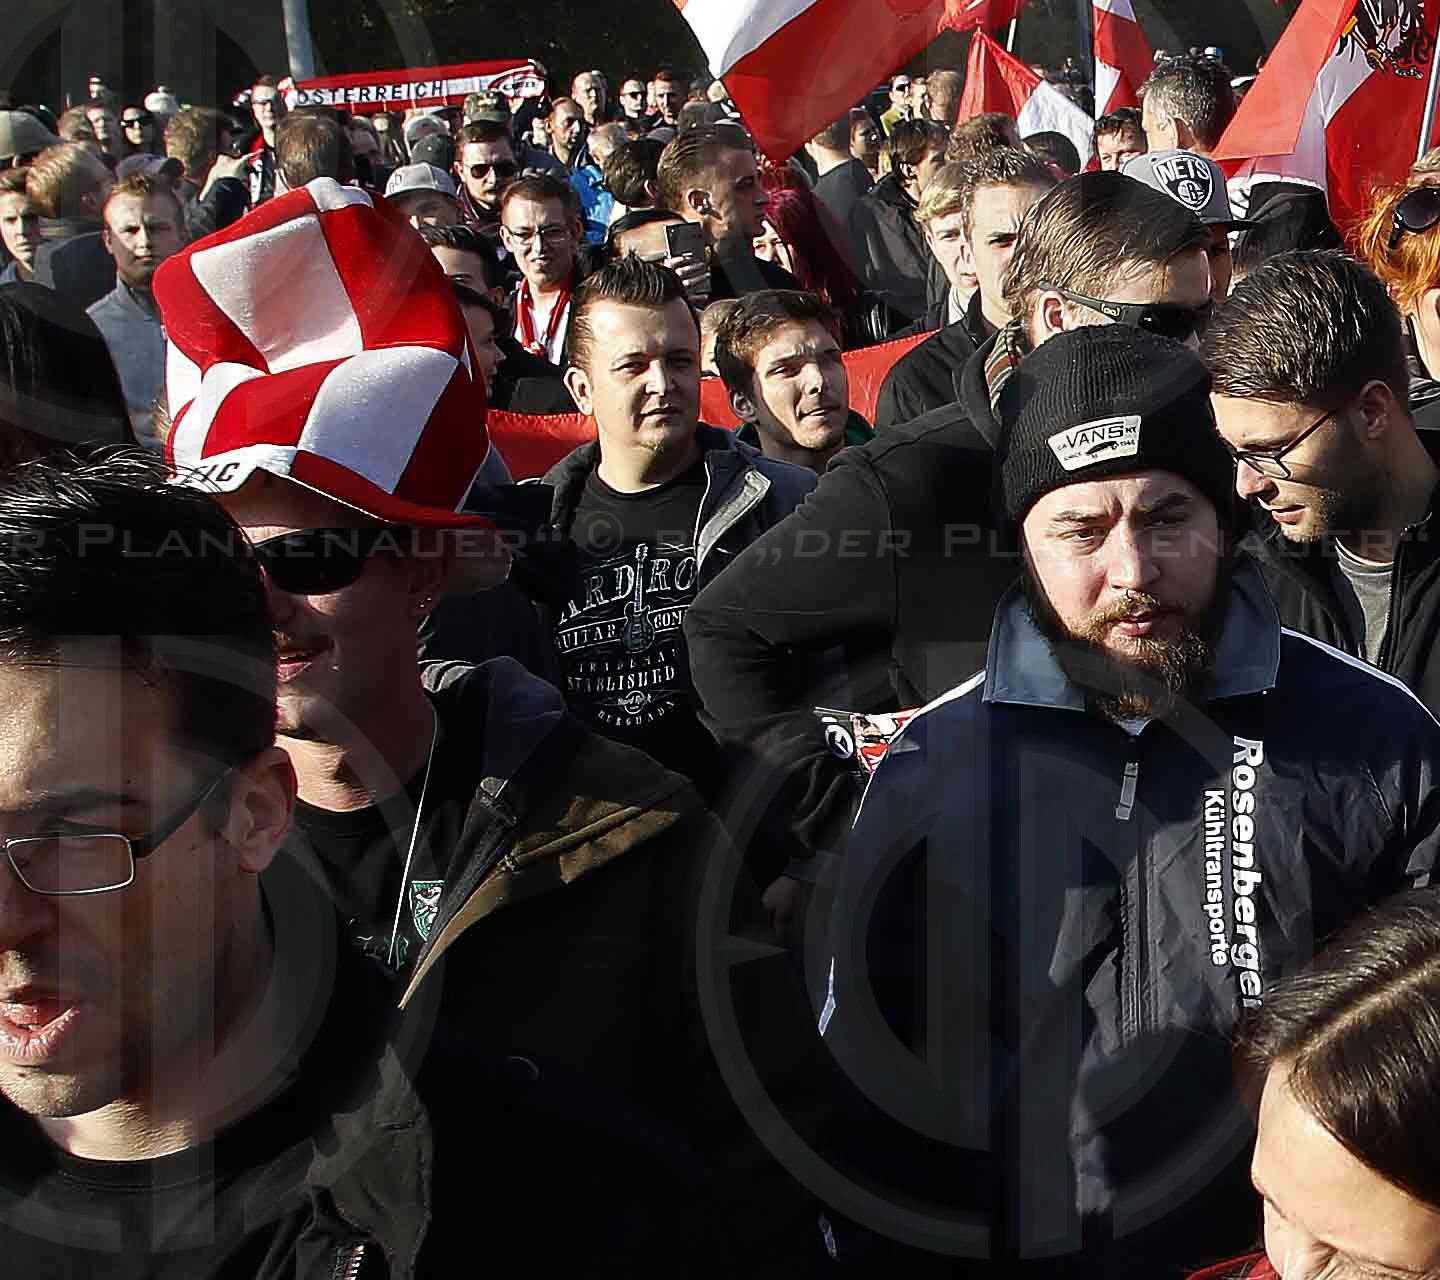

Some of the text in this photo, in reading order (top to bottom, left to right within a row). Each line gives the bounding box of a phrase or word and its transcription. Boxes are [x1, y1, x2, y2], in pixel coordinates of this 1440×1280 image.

[1156, 159, 1211, 184] NETS
[1065, 421, 1125, 449] VANS
[1202, 788, 1230, 967] Kühltransporte
